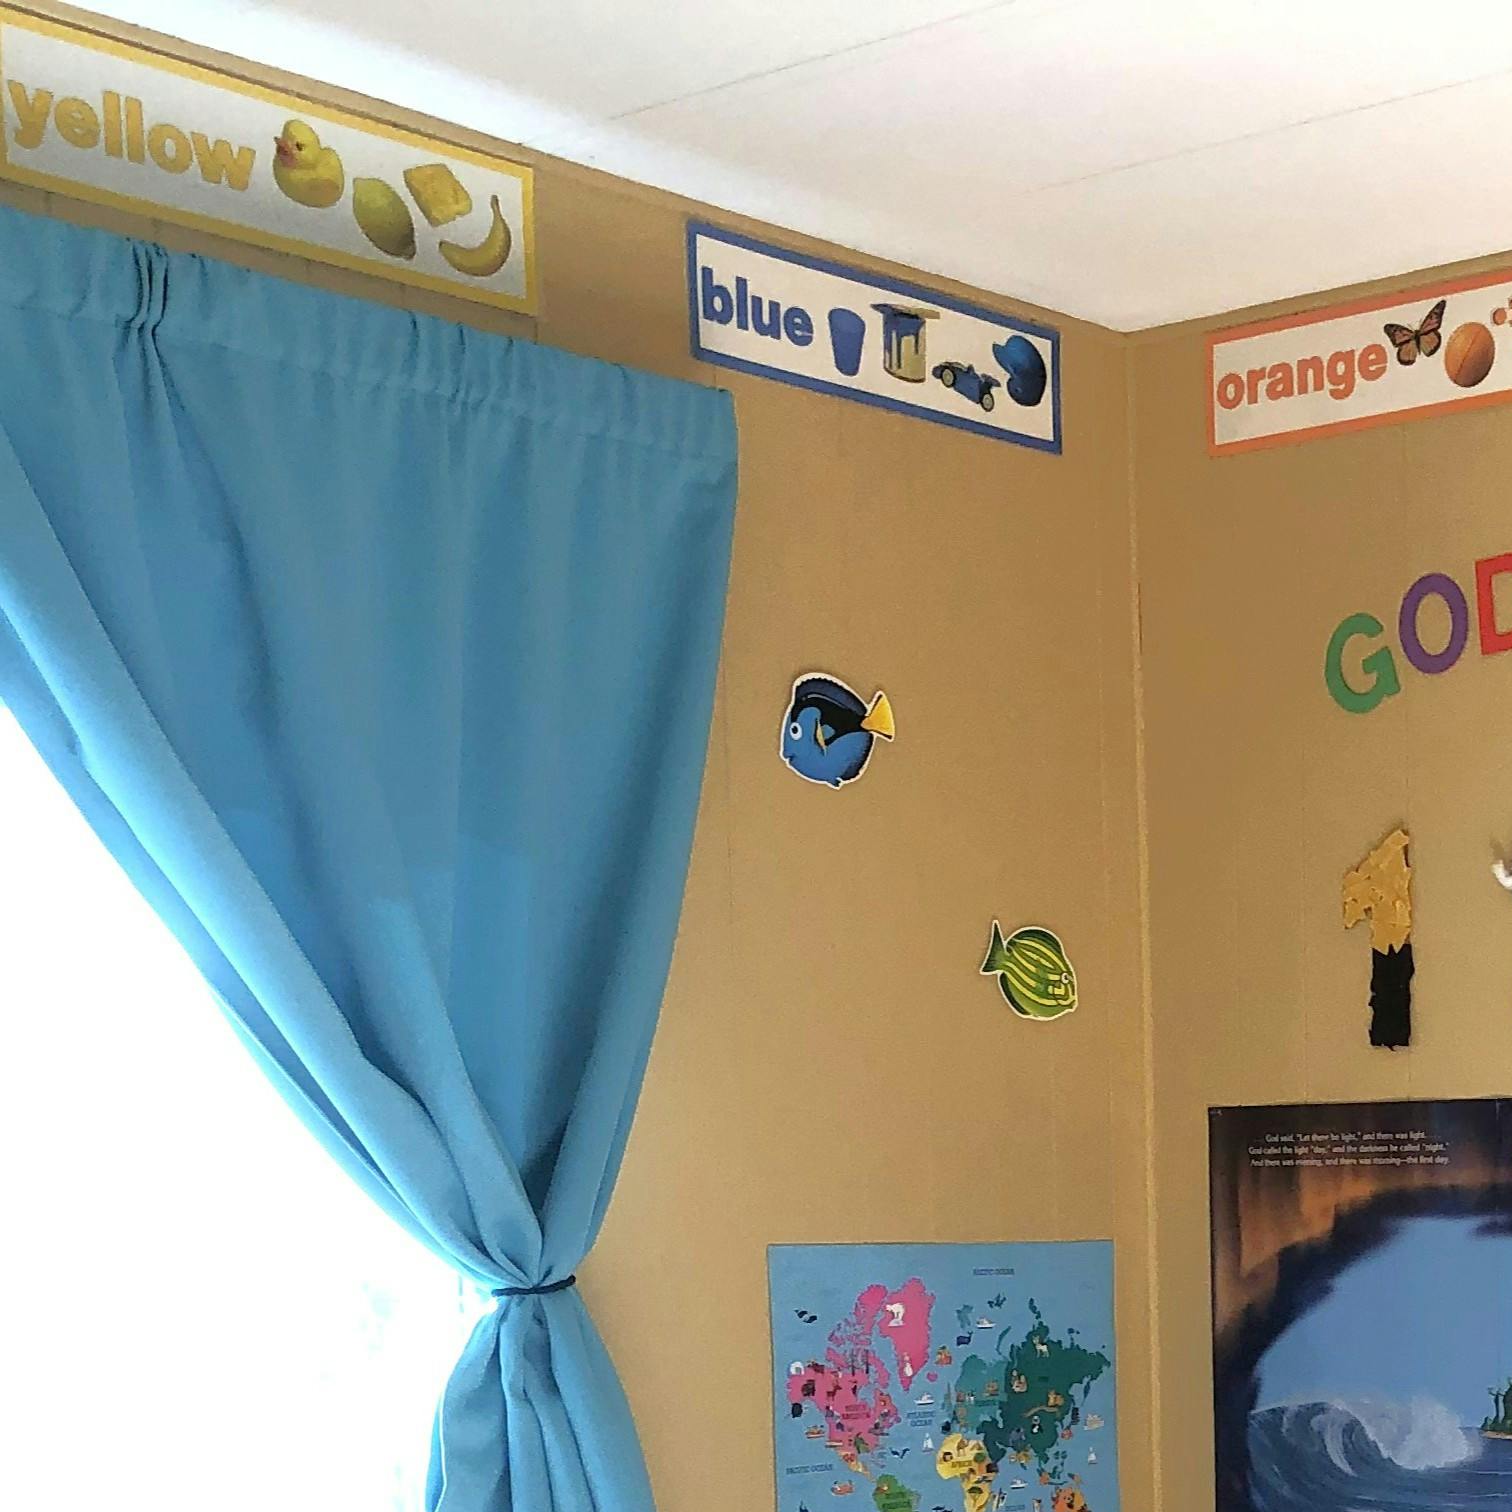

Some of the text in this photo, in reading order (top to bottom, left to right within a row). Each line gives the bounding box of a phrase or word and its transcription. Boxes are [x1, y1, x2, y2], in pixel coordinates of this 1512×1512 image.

[7, 79, 256, 191] yellow
[701, 266, 813, 346] blue
[1217, 343, 1388, 410] orange
[1343, 828, 1414, 1050] 1
